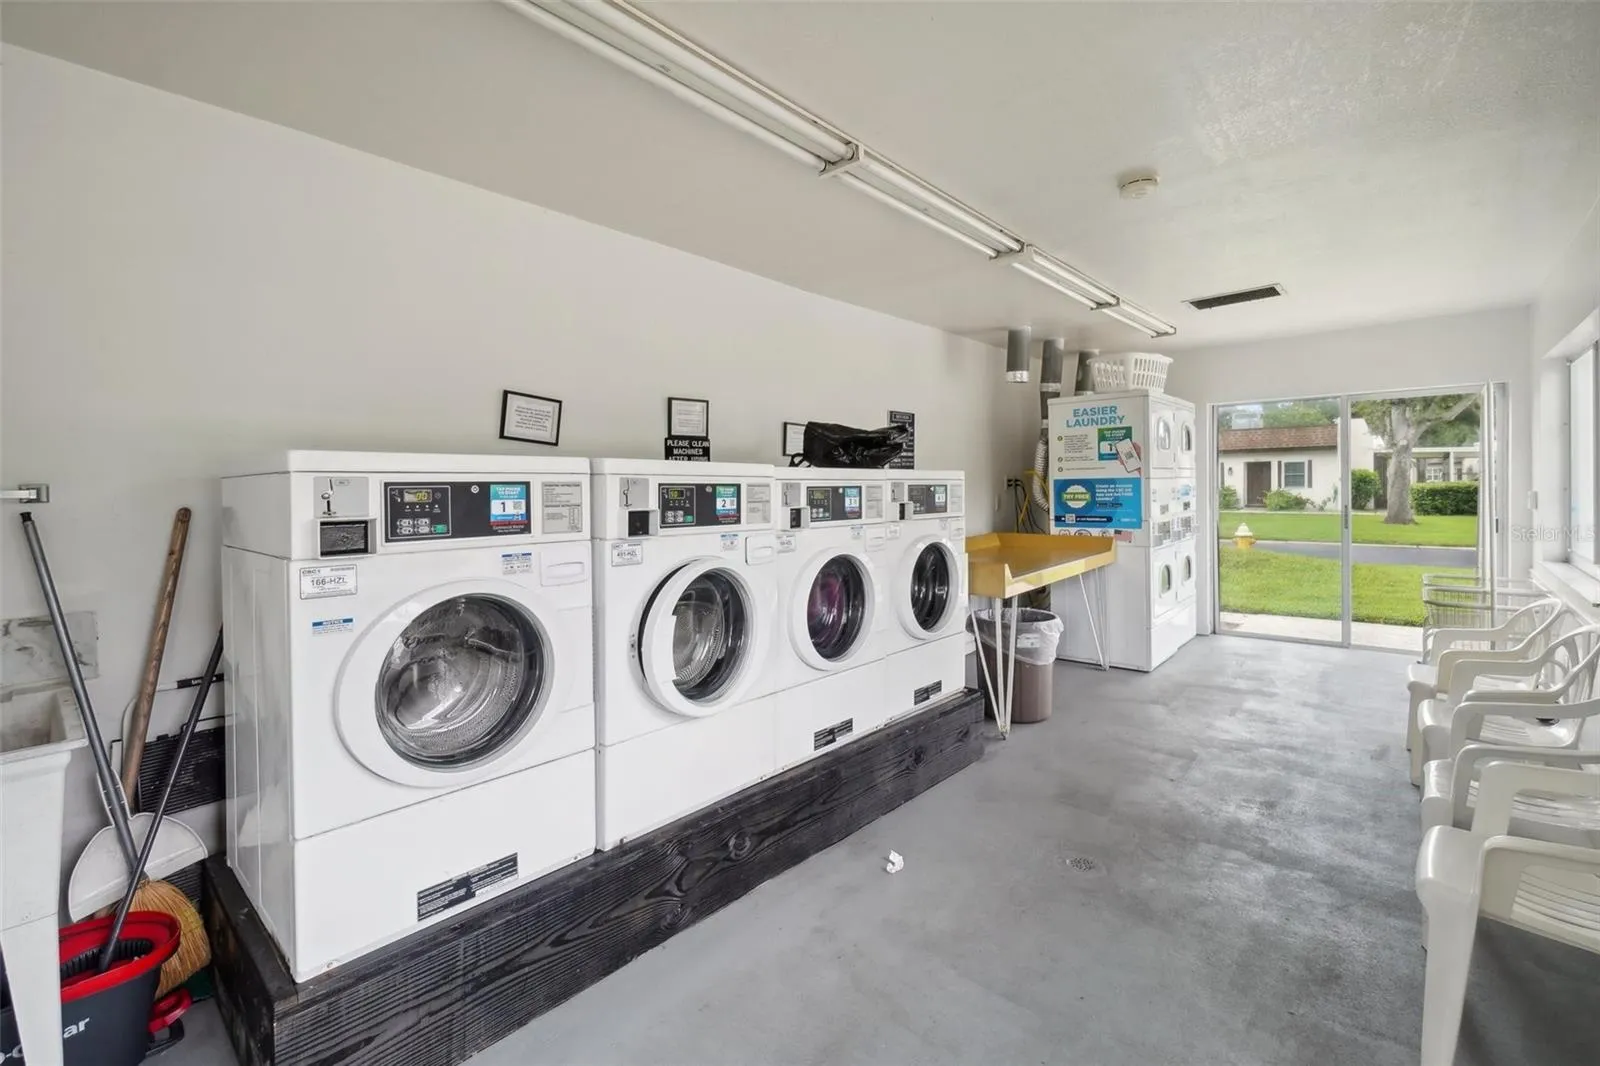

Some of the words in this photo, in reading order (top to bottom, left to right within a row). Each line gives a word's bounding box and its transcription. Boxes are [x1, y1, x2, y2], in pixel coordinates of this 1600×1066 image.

[1072, 406, 1118, 417] EASIER
[1066, 416, 1125, 428] LAUNDRY
[667, 439, 690, 448] PLEASE
[692, 440, 710, 448] CLEAN
[501, 501, 506, 513] 1
[721, 499, 727, 508] 2
